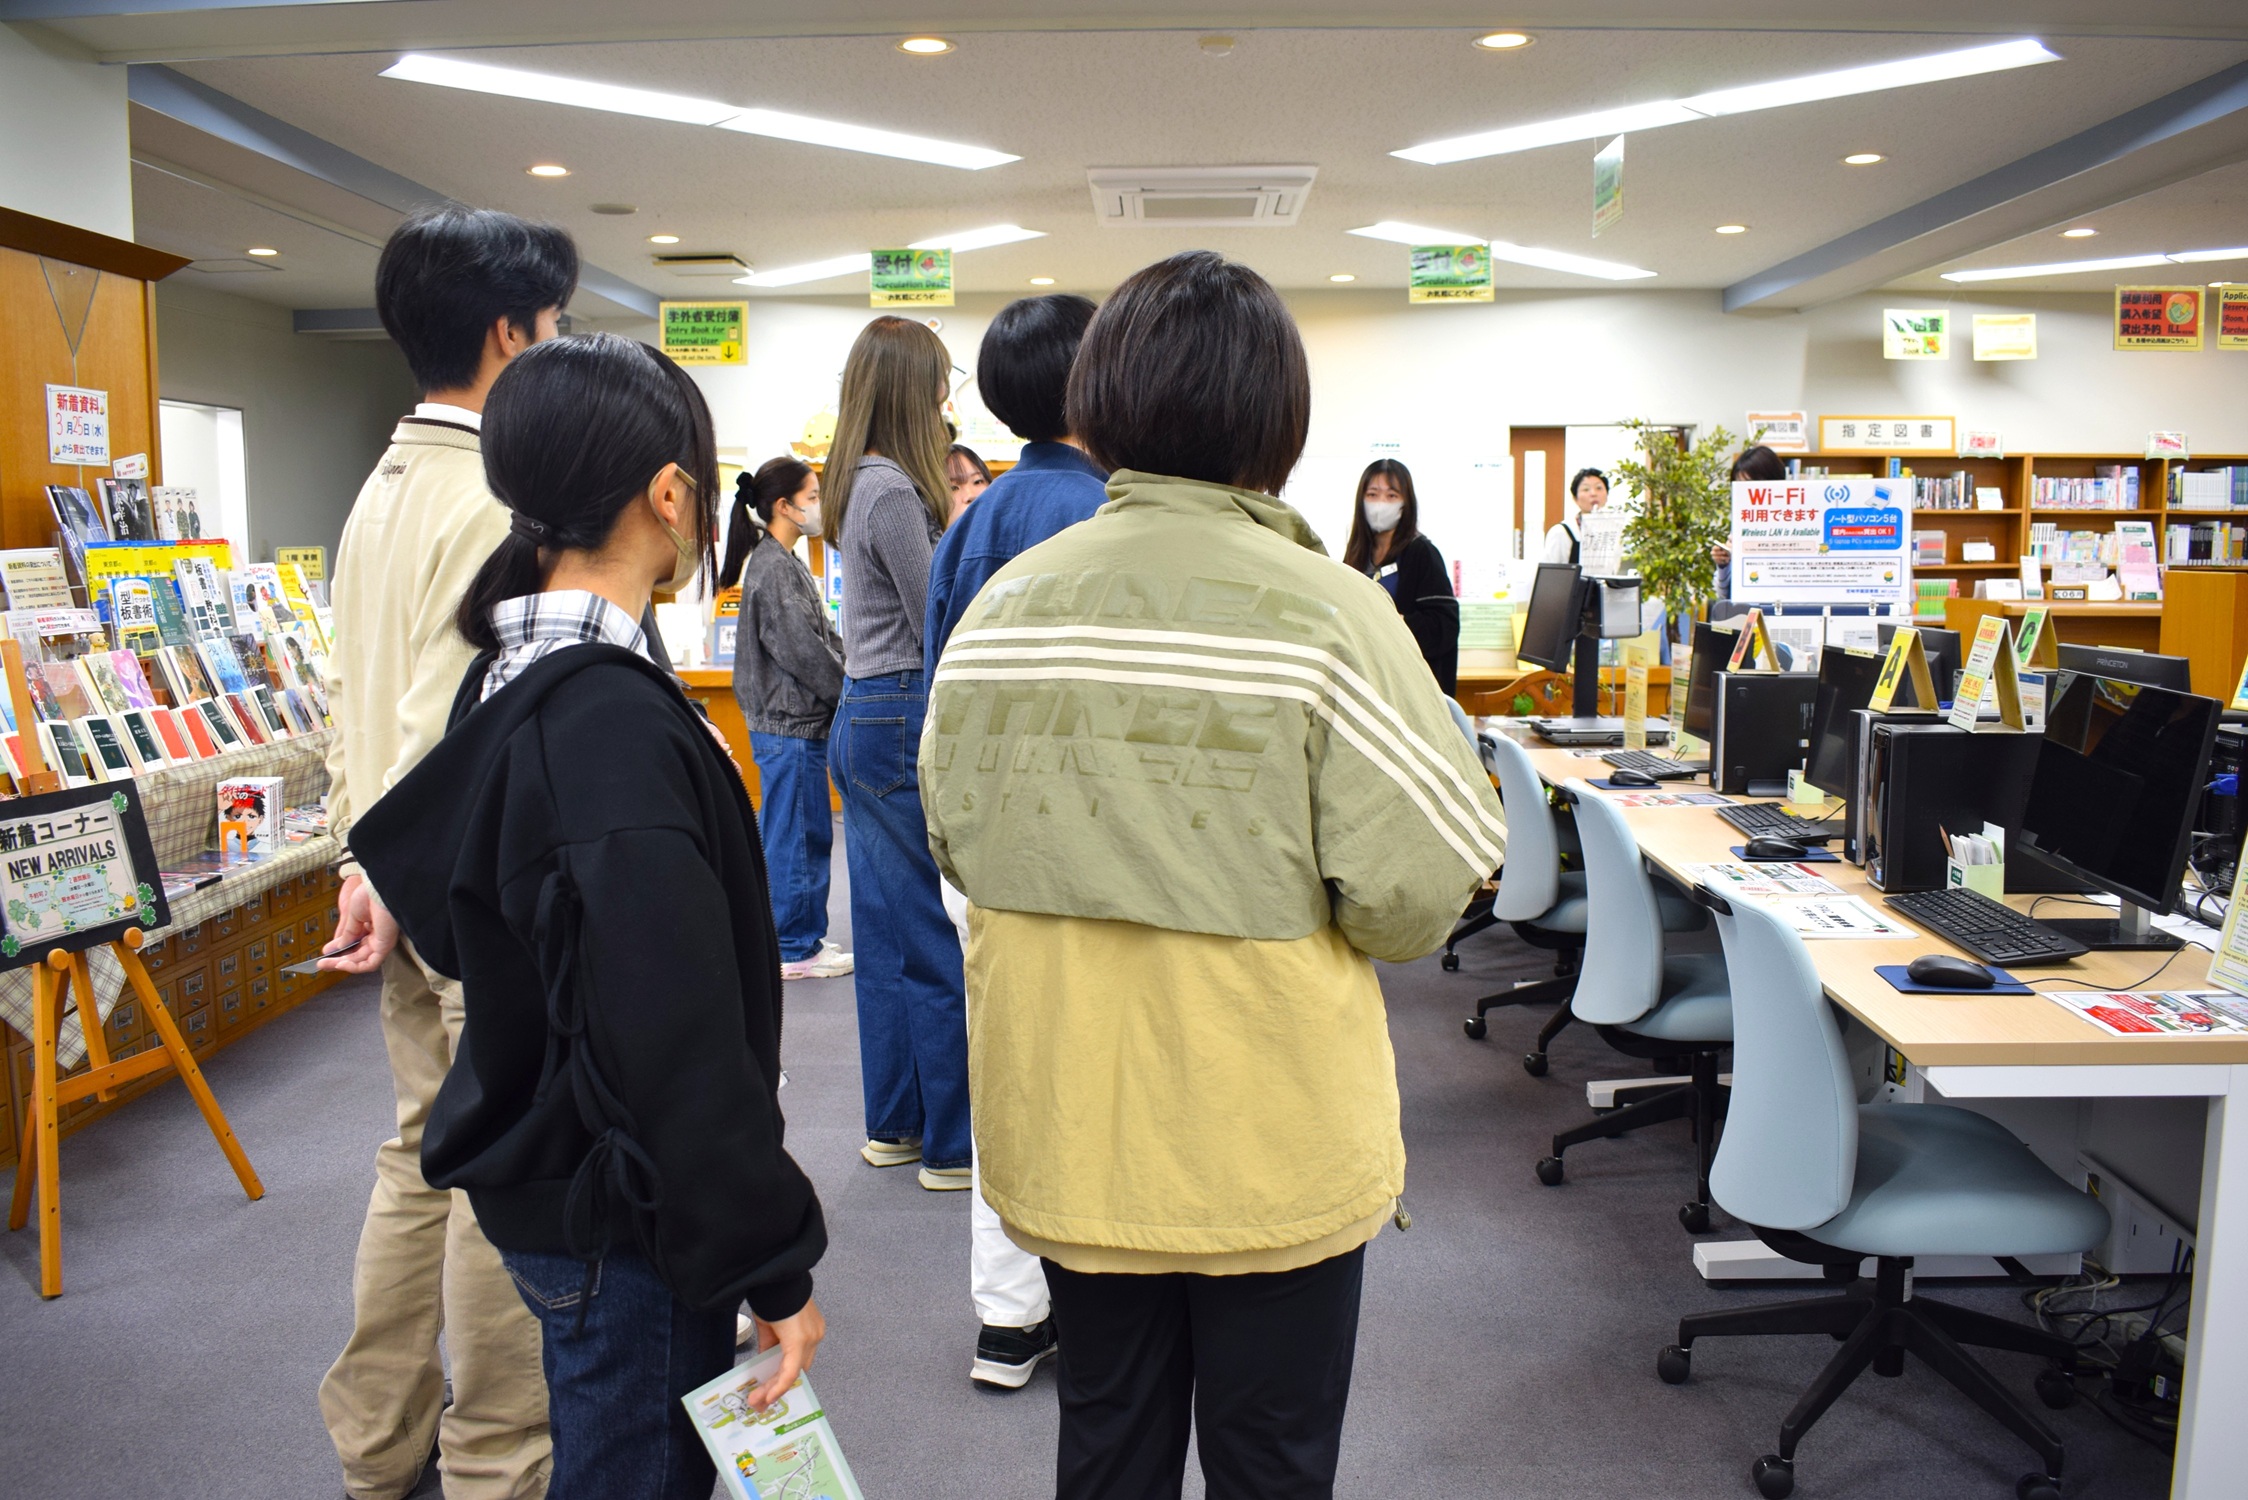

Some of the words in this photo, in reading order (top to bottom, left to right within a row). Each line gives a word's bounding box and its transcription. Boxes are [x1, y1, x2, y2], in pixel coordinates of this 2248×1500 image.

[874, 254, 912, 275] 受付
[666, 326, 688, 335] Entry
[2121, 324, 2161, 335] 貸出予約
[666, 337, 698, 345] External
[701, 337, 718, 345] User
[57, 392, 99, 414] 新着資料
[1842, 423, 1933, 438] 指定図書
[1748, 487, 1805, 506] Wi-Fi
[1741, 509, 1820, 523] 利用できます
[1741, 528, 1767, 537] Wireless
[1769, 528, 1783, 536] LAN
[1784, 528, 1789, 536] is
[1790, 528, 1820, 536] Available
[2017, 621, 2036, 654] C
[1879, 645, 1902, 689] A
[2096, 657, 2129, 669] PRINCETON
[0, 812, 109, 851] 新着コーナー
[8, 855, 42, 881] NEW
[47, 839, 117, 872] ARRIVALS
